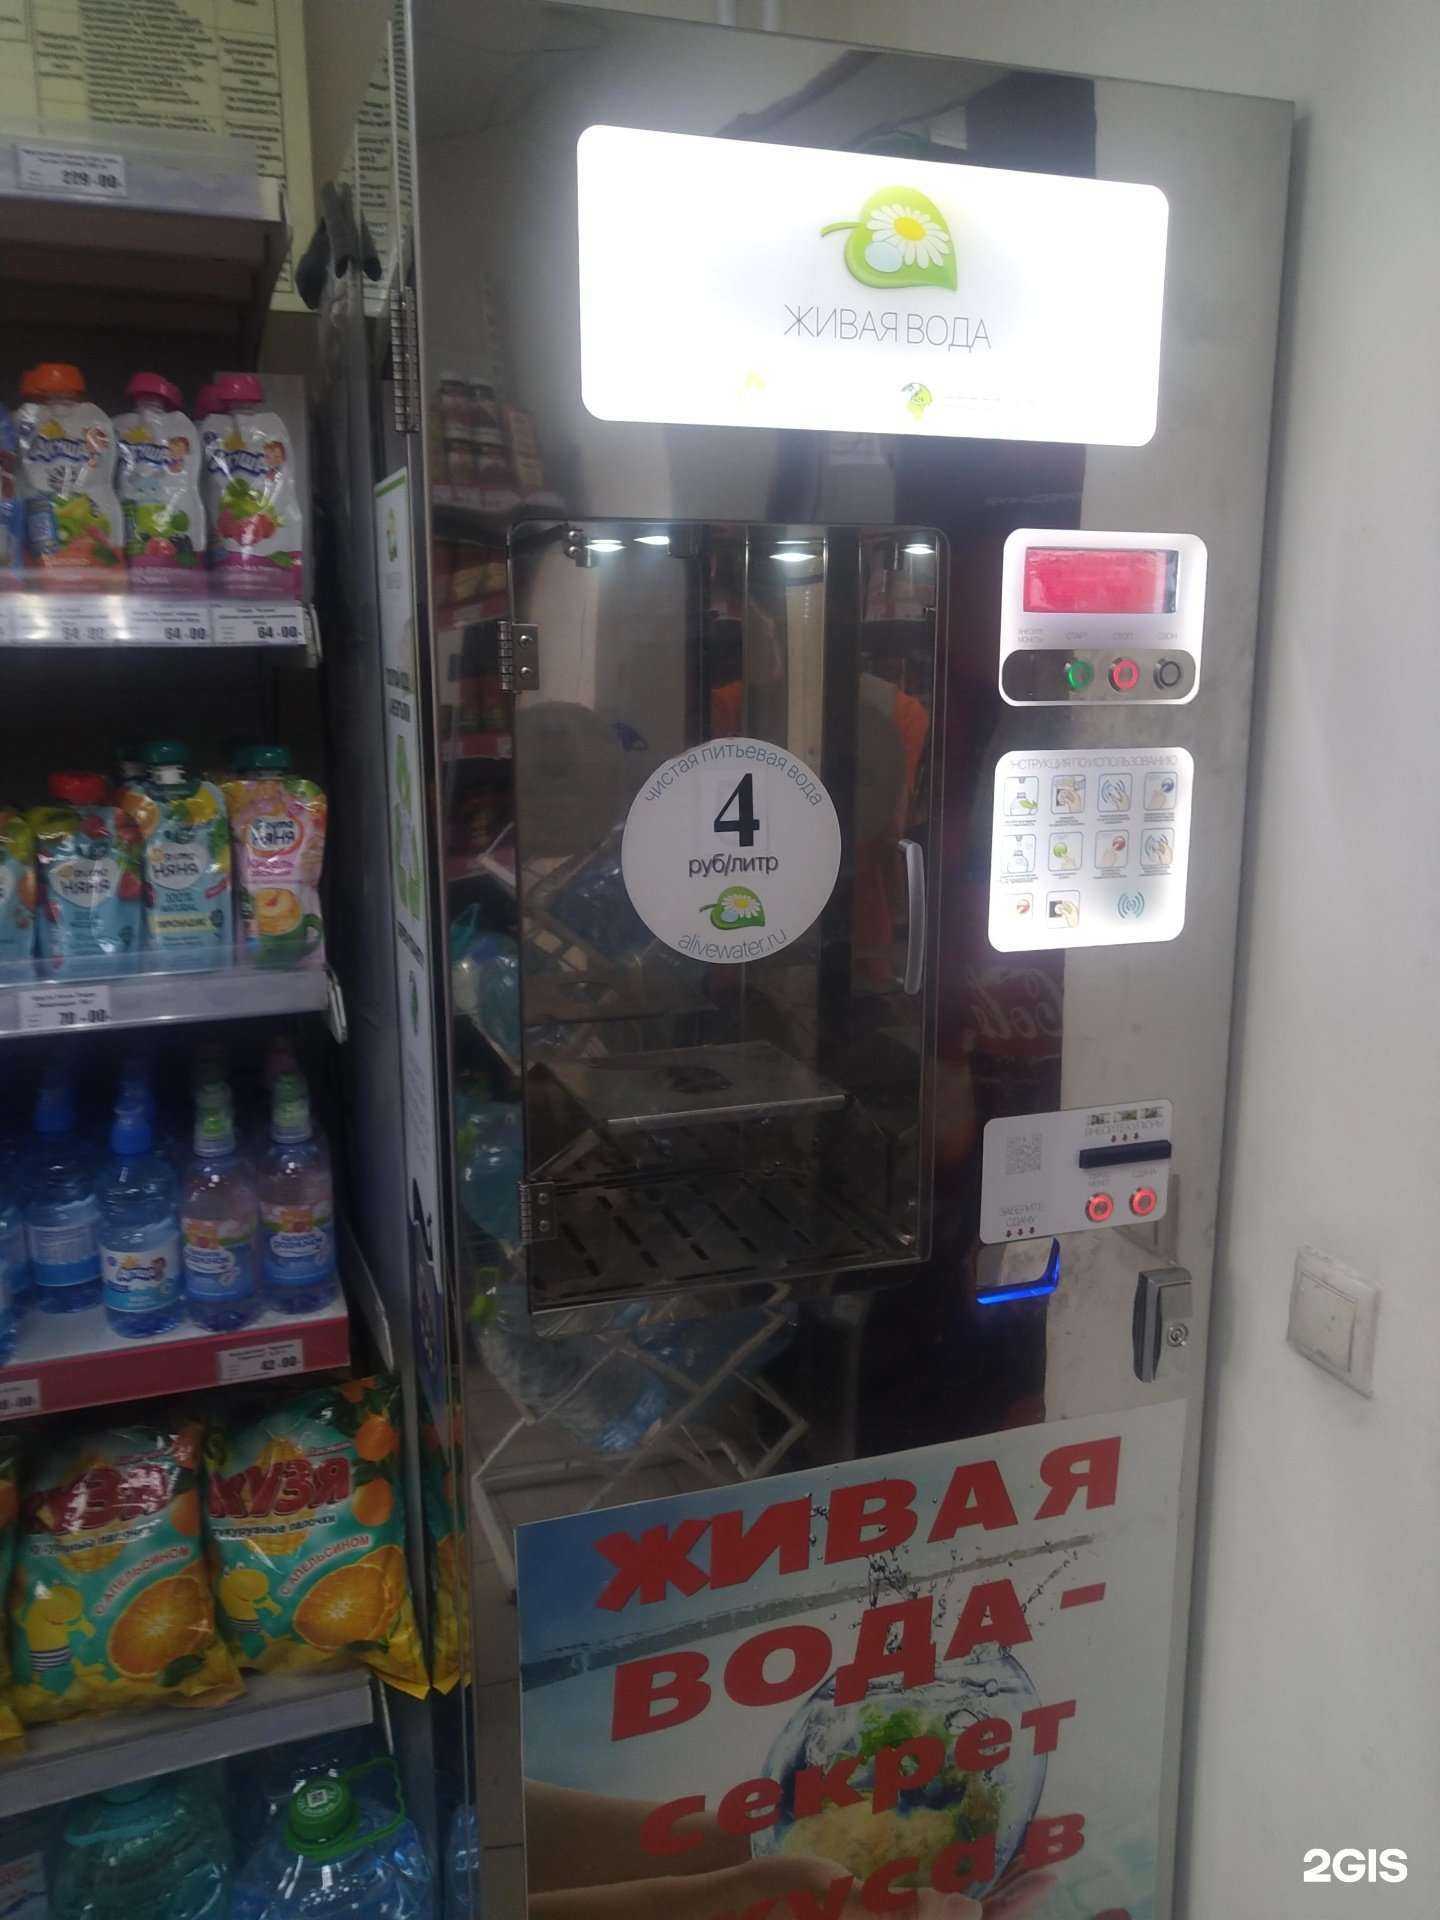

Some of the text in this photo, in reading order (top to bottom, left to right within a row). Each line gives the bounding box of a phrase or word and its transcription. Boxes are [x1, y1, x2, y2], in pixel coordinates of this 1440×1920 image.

[783, 304, 992, 354] ЖИВАЯ ВОДА
[645, 744, 823, 806] чистая питьевая вода
[713, 772, 760, 847] 4
[688, 853, 779, 878] руб/литр
[678, 929, 787, 960] alivewater.ru
[592, 1436, 1122, 1612] ЖИВАЯ
[638, 1700, 1077, 1857] секрет
